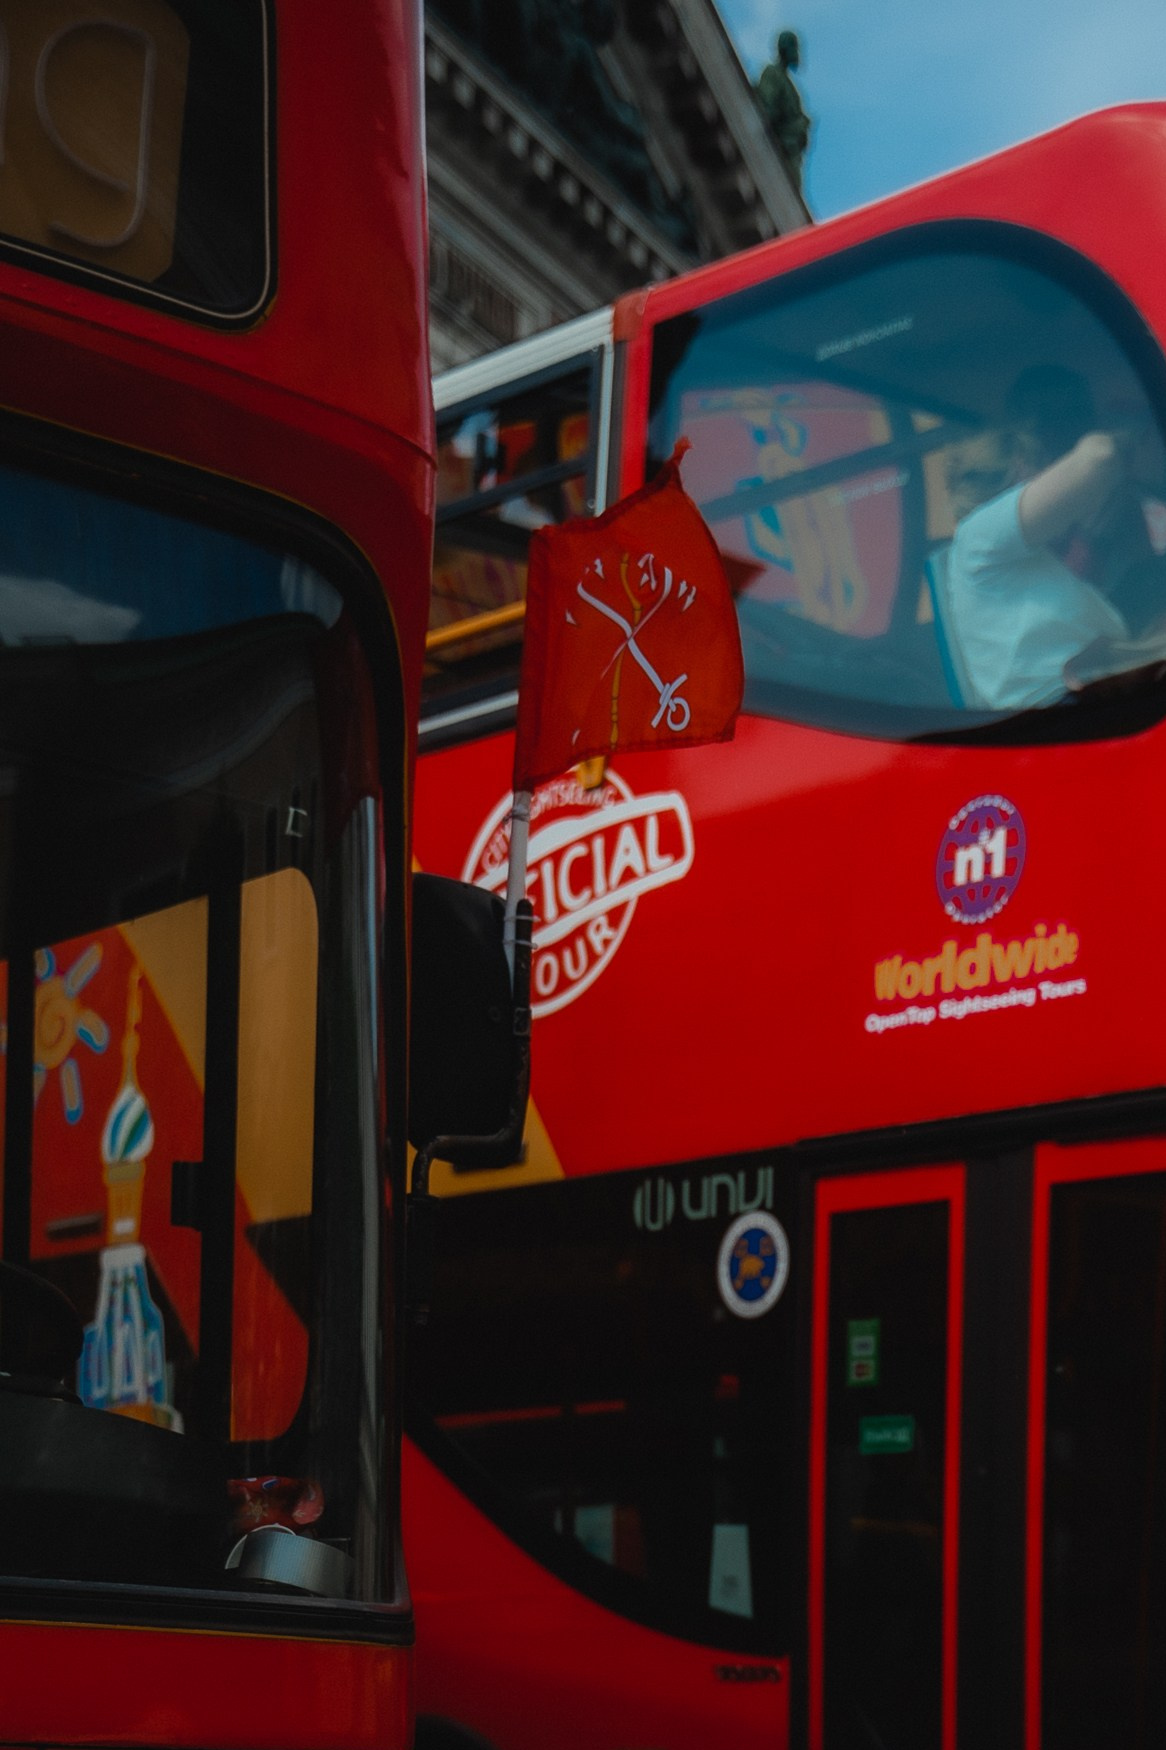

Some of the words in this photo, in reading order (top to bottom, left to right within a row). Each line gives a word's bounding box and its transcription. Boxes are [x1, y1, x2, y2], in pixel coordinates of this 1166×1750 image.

[534, 912, 617, 996] OUR
[874, 923, 1079, 1000] Worldwide
[1038, 978, 1087, 1000] Tours
